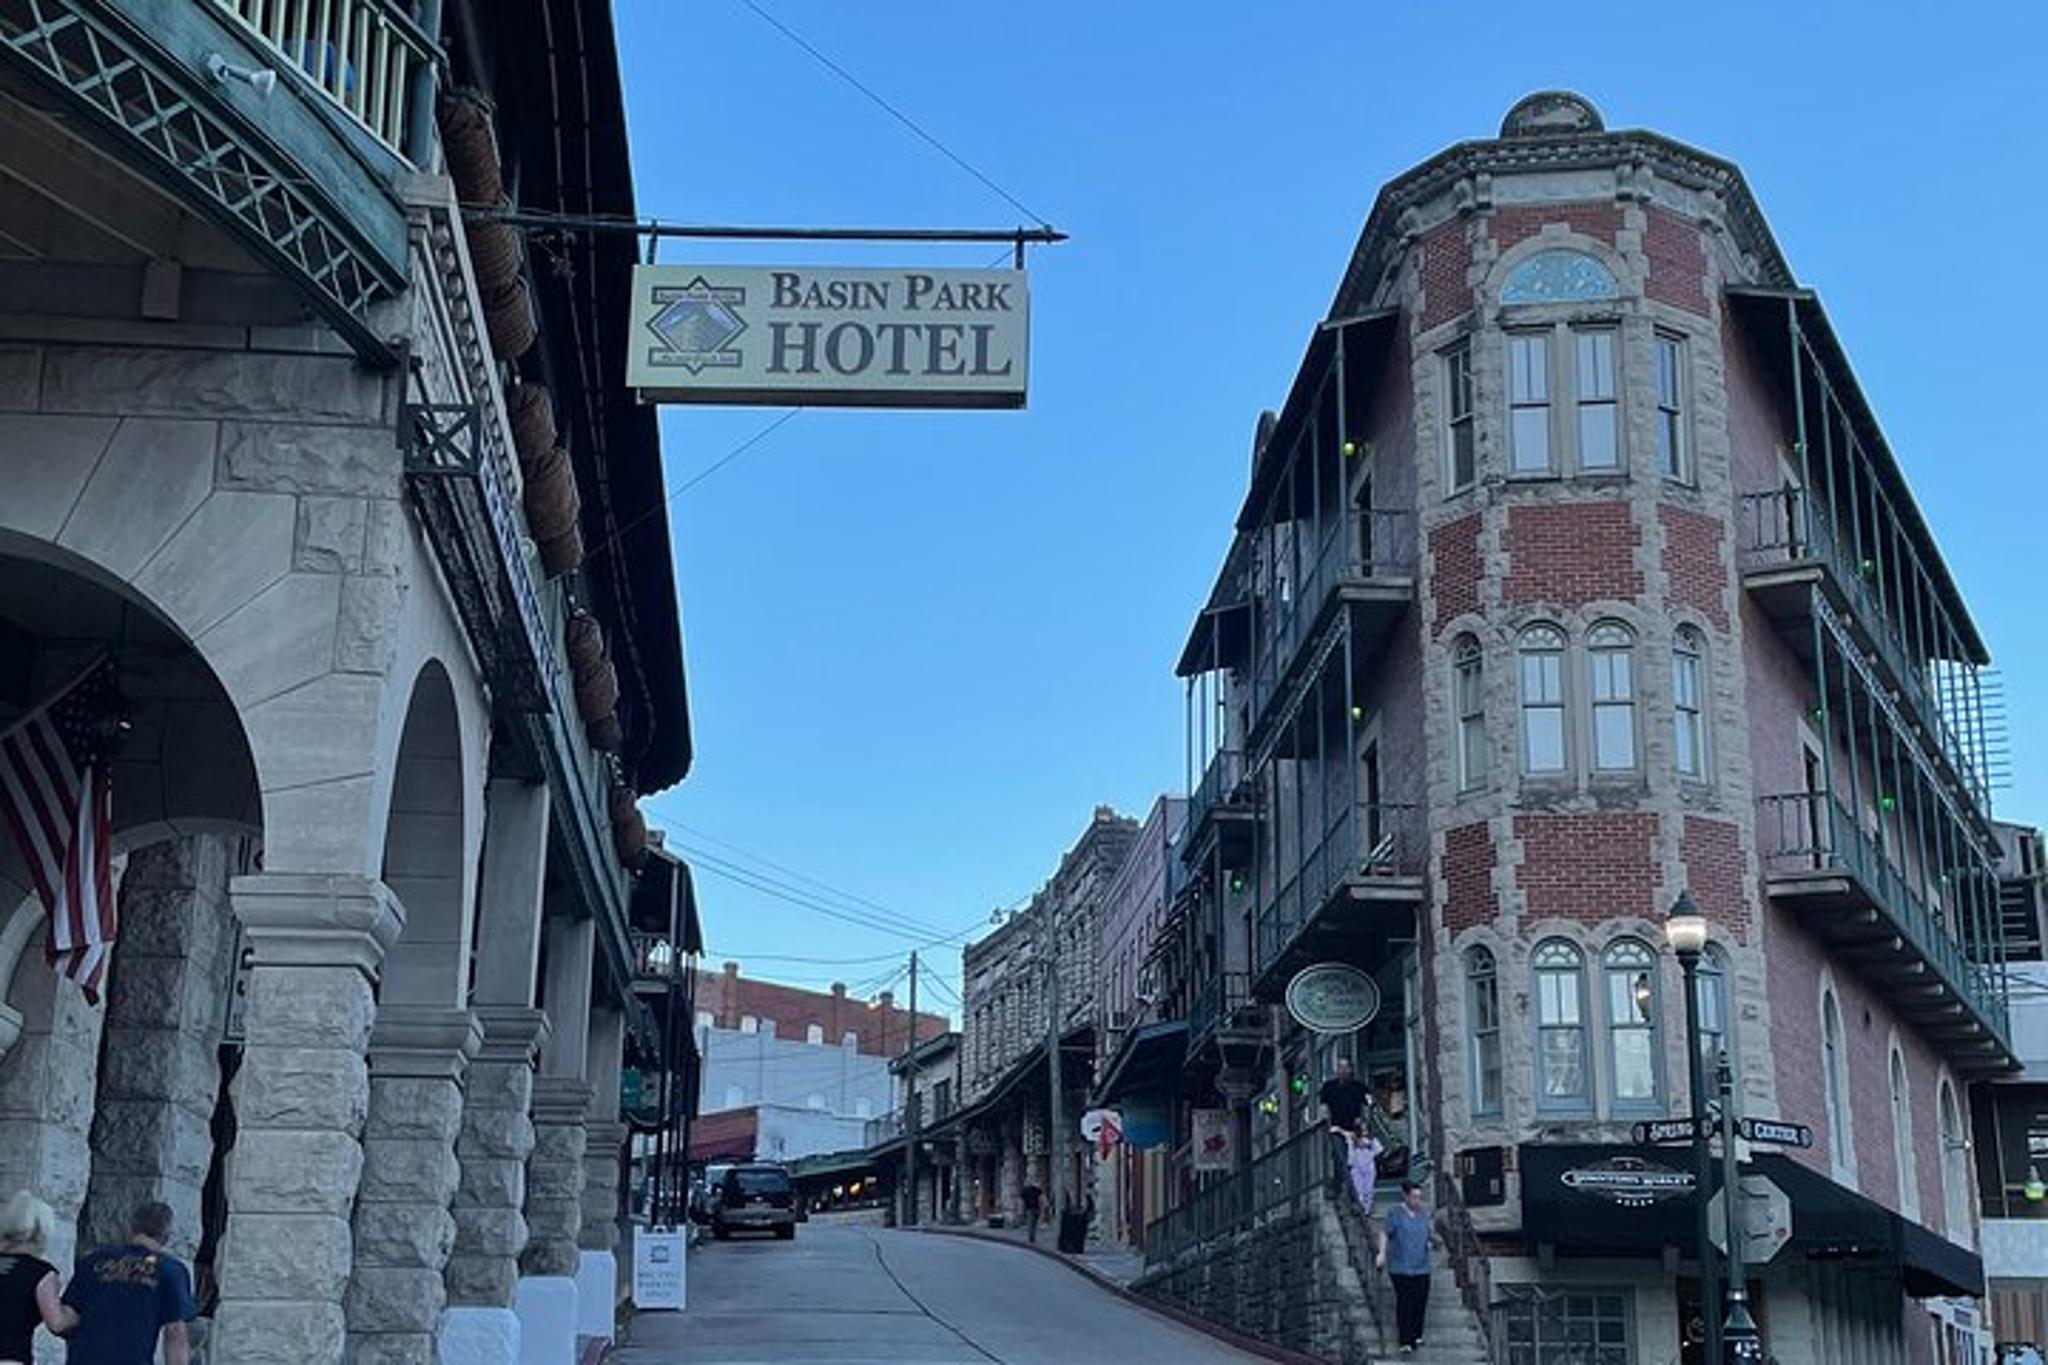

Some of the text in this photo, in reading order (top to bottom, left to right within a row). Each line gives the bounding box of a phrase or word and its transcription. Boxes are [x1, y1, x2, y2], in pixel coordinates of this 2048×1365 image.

[770, 272, 1012, 311] BASIN PARK
[765, 321, 1012, 376] HOTEL
